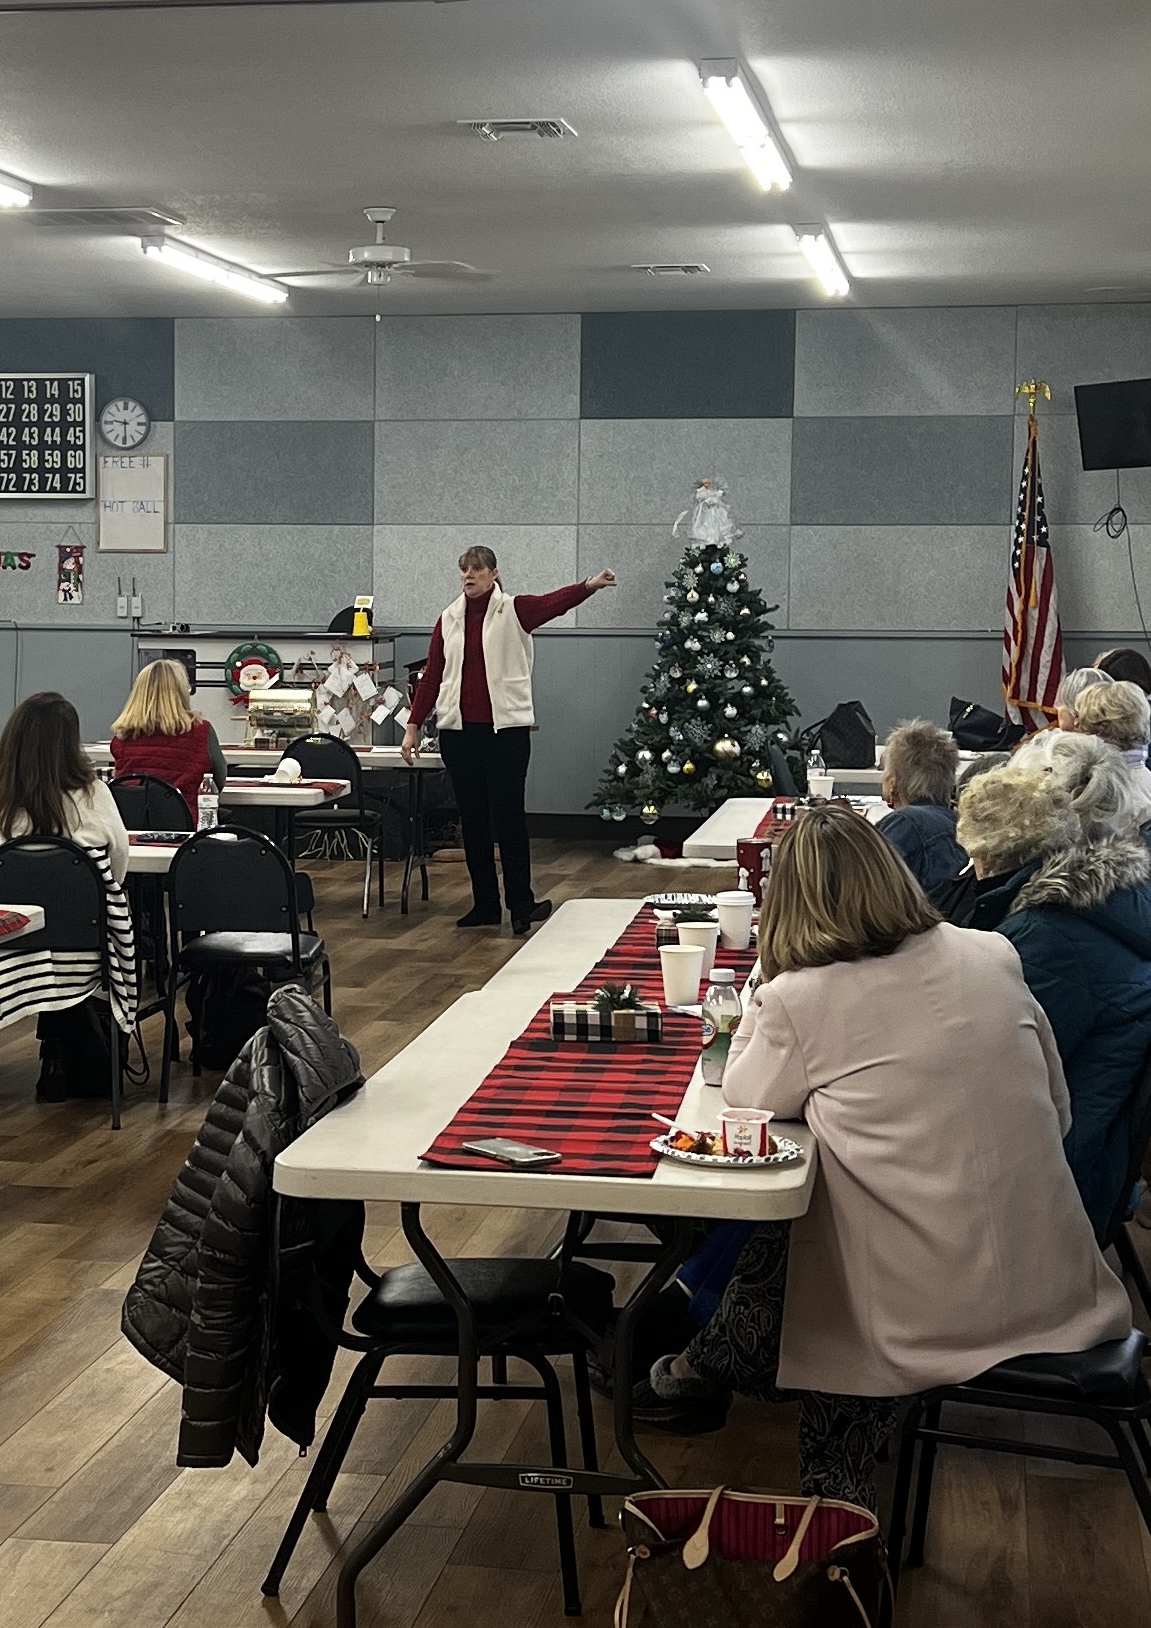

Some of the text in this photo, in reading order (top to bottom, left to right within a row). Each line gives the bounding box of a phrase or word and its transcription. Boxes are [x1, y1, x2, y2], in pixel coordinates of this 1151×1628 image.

[0, 380, 15, 399] 12
[22, 380, 37, 399] 13
[44, 380, 60, 399] 14
[67, 380, 82, 399] 15
[21, 403, 39, 422] 28
[43, 403, 61, 422] 29
[66, 403, 83, 422] 30
[0, 426, 17, 446] 42
[21, 426, 39, 446] 43
[43, 426, 62, 445] 44
[66, 426, 84, 446] 45
[0, 449, 17, 469] 57
[21, 449, 39, 469] 58
[44, 449, 61, 469] 59
[66, 449, 84, 469] 60
[103, 456, 137, 469] FREE
[0, 472, 17, 492] 72
[22, 472, 39, 492] 73
[44, 473, 61, 492] 74
[67, 473, 84, 492] 75
[103, 501, 160, 514] HOT BALL
[524, 1476, 568, 1486] LIFETIME
